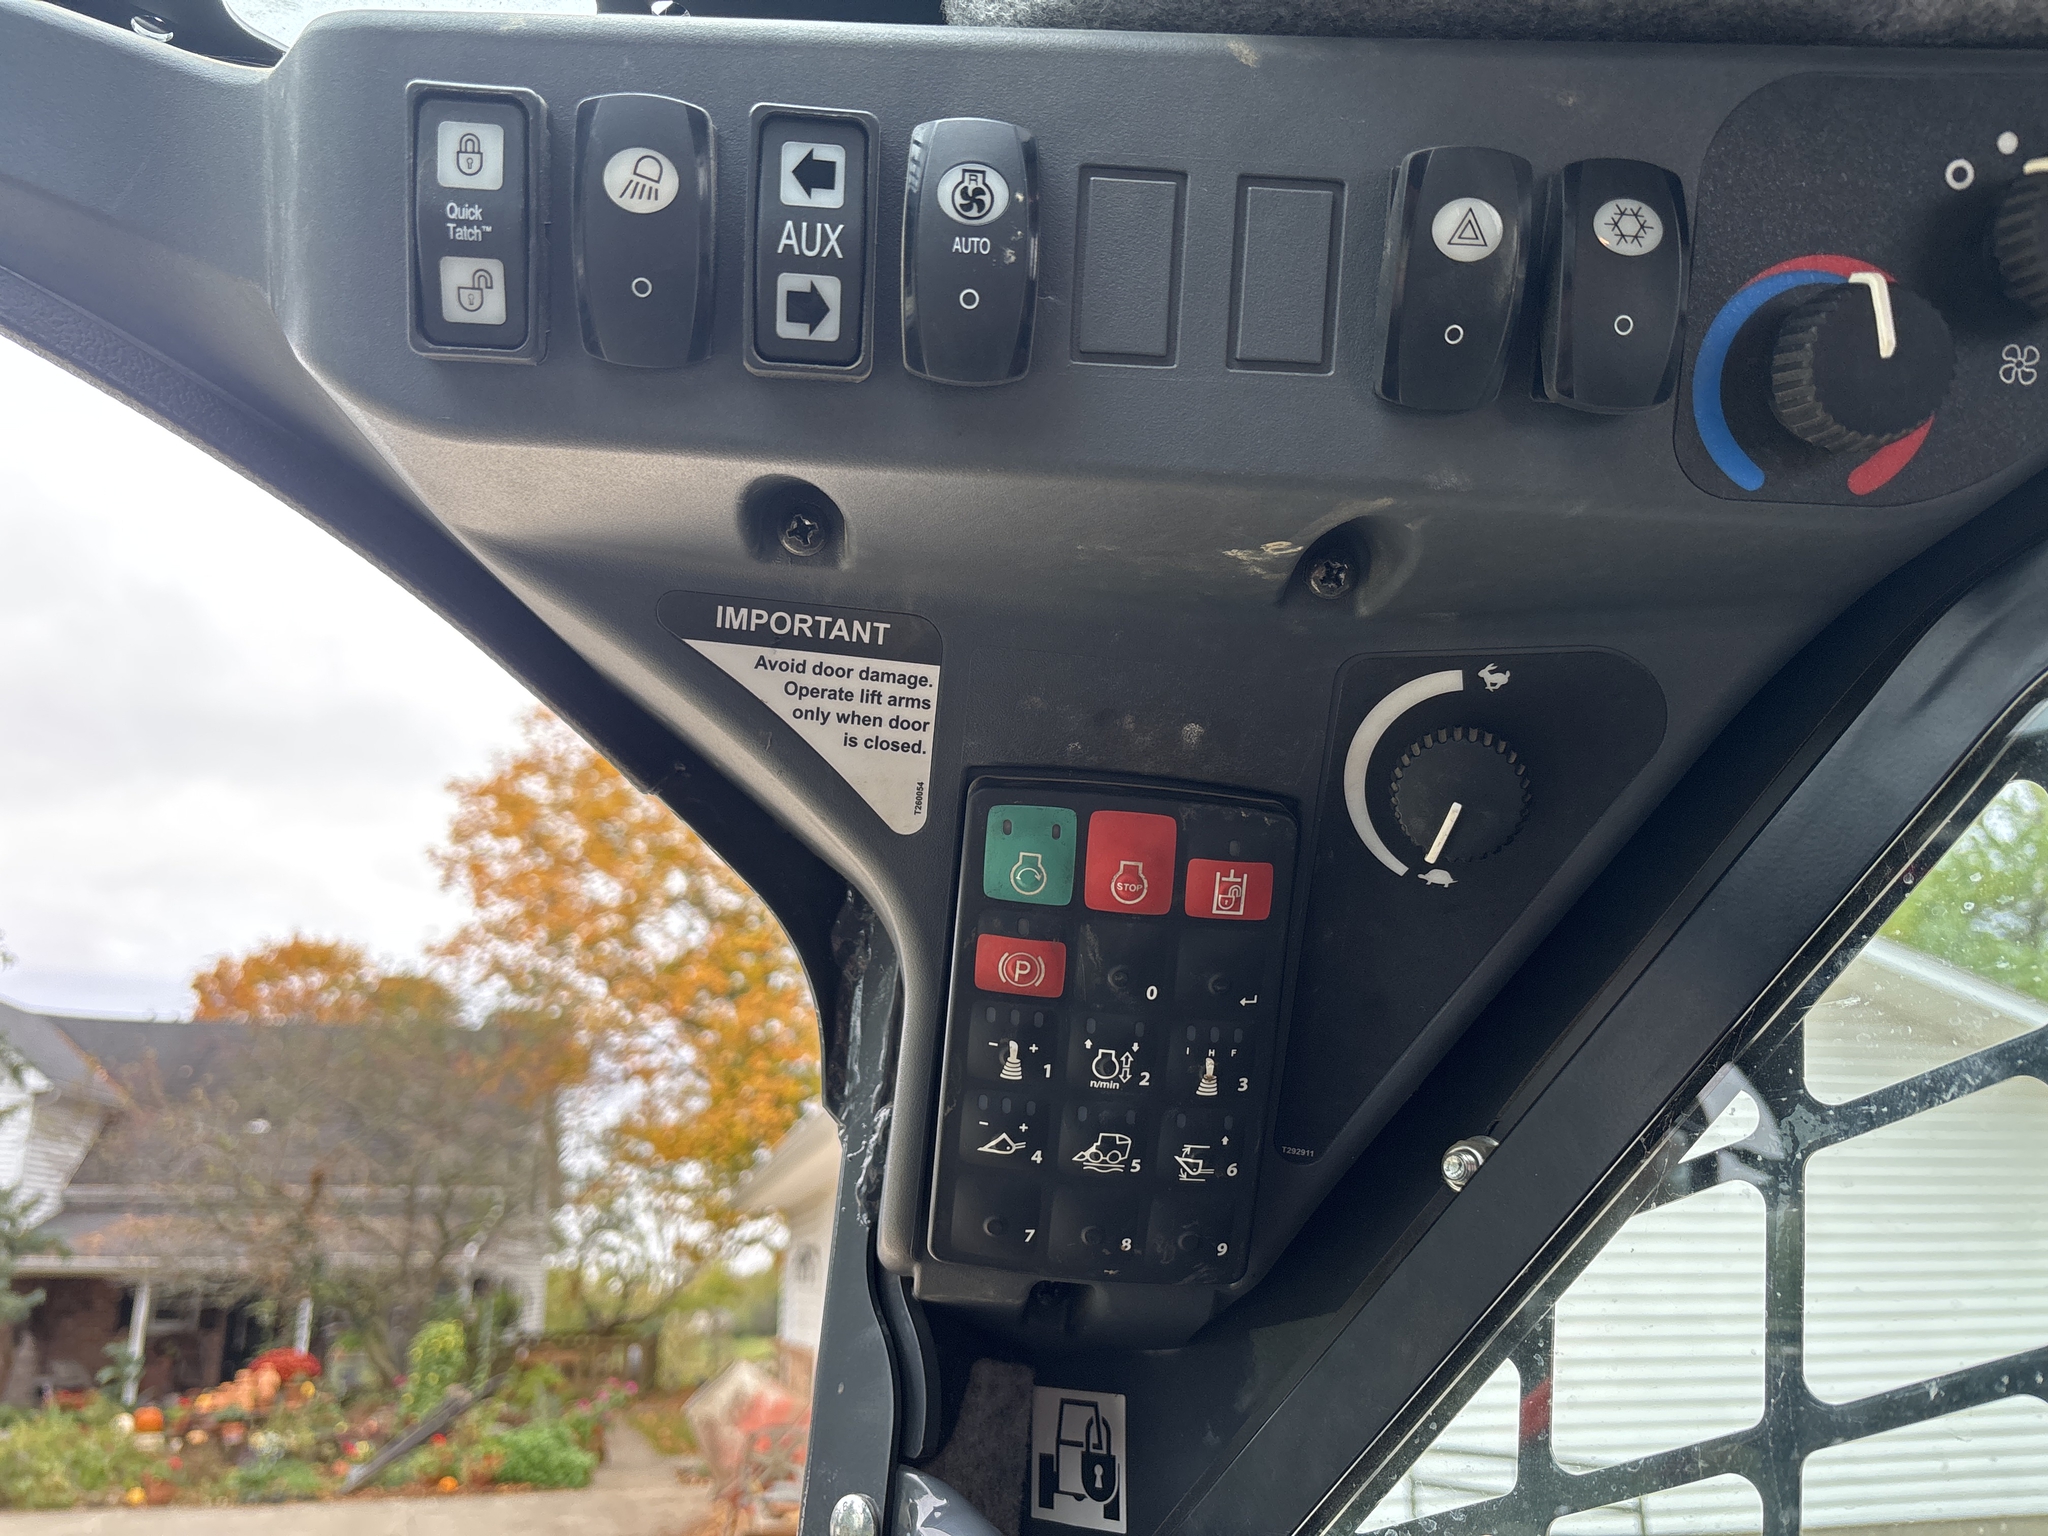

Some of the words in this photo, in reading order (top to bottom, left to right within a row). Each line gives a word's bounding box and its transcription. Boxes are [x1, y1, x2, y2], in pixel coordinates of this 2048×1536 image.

[446, 202, 483, 221] Quick
[777, 220, 845, 259] AUX
[952, 236, 991, 255] AUTO
[715, 605, 891, 645] IMPORTANT
[754, 655, 807, 674] Avoid
[812, 661, 854, 679] door
[858, 667, 934, 689] damage.
[784, 681, 855, 703] Operate
[859, 689, 883, 705] lift
[887, 696, 932, 710] arms
[792, 706, 831, 726] only
[836, 711, 883, 727] when
[888, 718, 930, 732] door
[843, 733, 858, 748] is
[863, 735, 927, 755] closed.
[914, 781, 925, 816] T260054
[1116, 882, 1143, 893] STOP
[1014, 960, 1031, 982] P
[1146, 985, 1158, 1001] 0
[1208, 1048, 1216, 1057] H
[1231, 1048, 1237, 1057] F
[1043, 1063, 1051, 1078] 1
[1090, 1079, 1120, 1091] n/min
[1138, 1071, 1151, 1086] 2
[1237, 1077, 1249, 1092] 3
[1031, 1150, 1043, 1164] 4
[1281, 1145, 1315, 1157] T292911
[1129, 1158, 1142, 1173] 5
[1226, 1163, 1238, 1177] 6
[1024, 1228, 1036, 1243] 7
[1121, 1238, 1132, 1252] 8
[1217, 1242, 1229, 1257] 9
